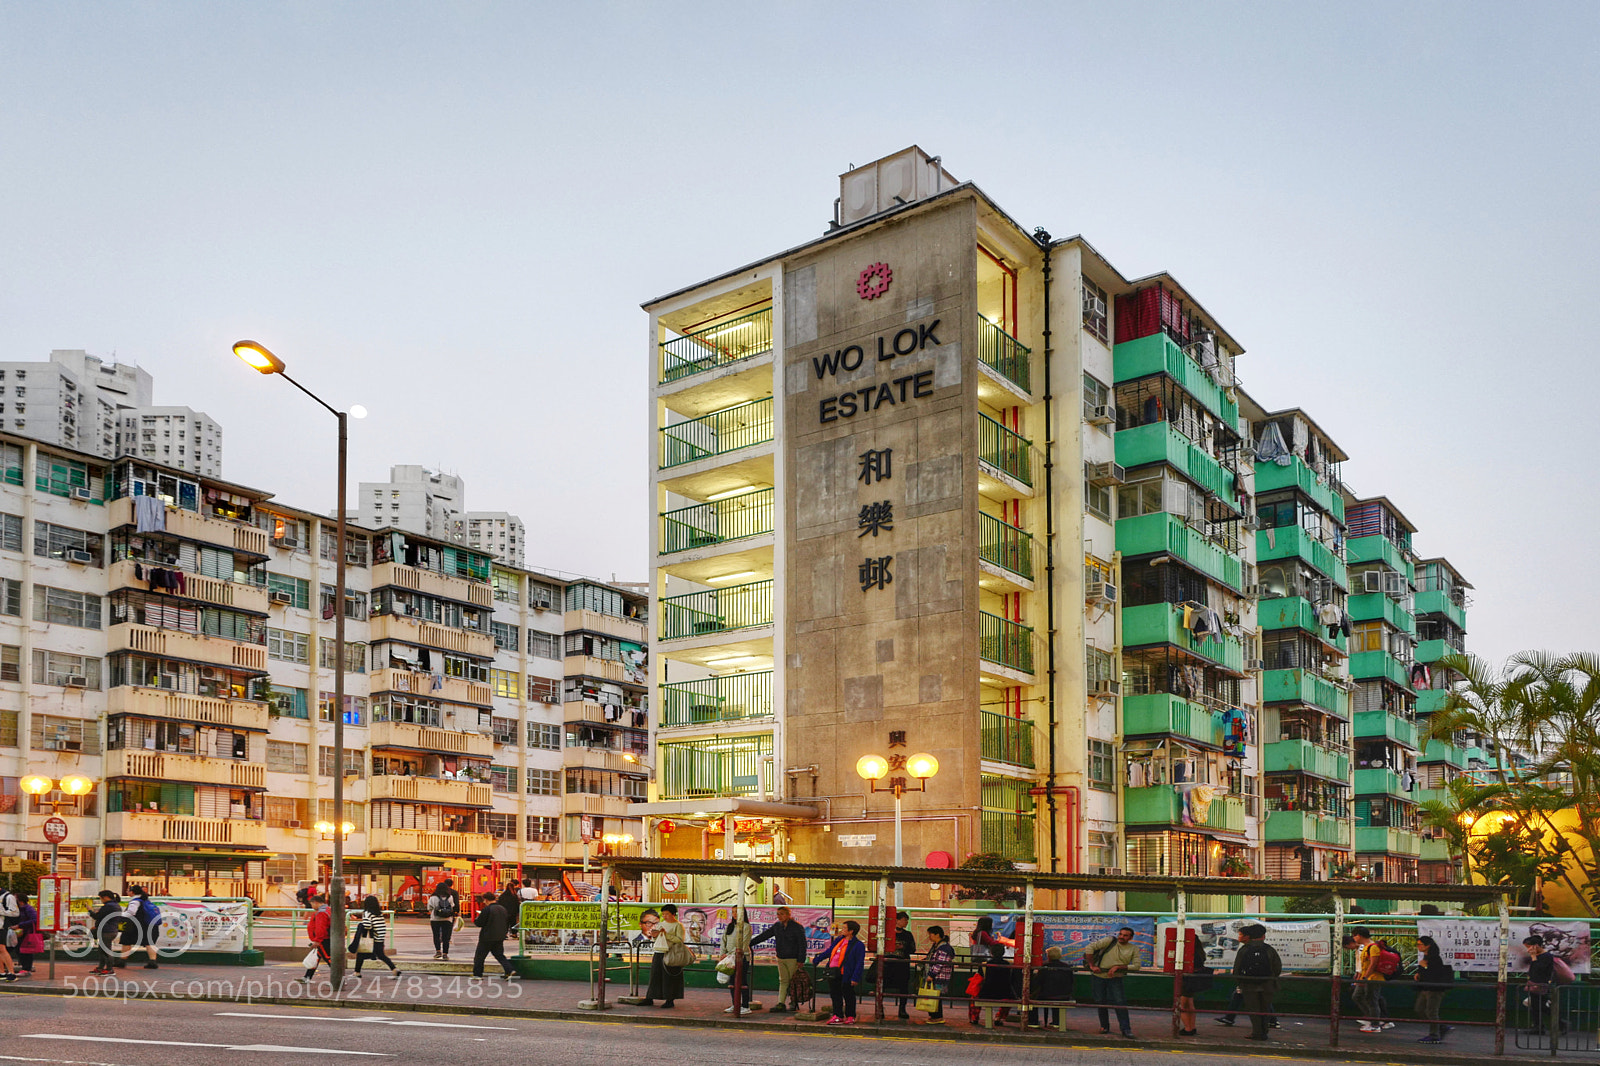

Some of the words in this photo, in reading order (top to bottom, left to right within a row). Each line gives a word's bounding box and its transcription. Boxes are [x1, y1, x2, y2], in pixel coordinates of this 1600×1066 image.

[812, 345, 864, 379] WO
[878, 319, 941, 362] LOK
[819, 370, 934, 424] ESTATE
[858, 448, 893, 592] 和樂邨
[1429, 930, 1516, 939] DIGISOLAE
